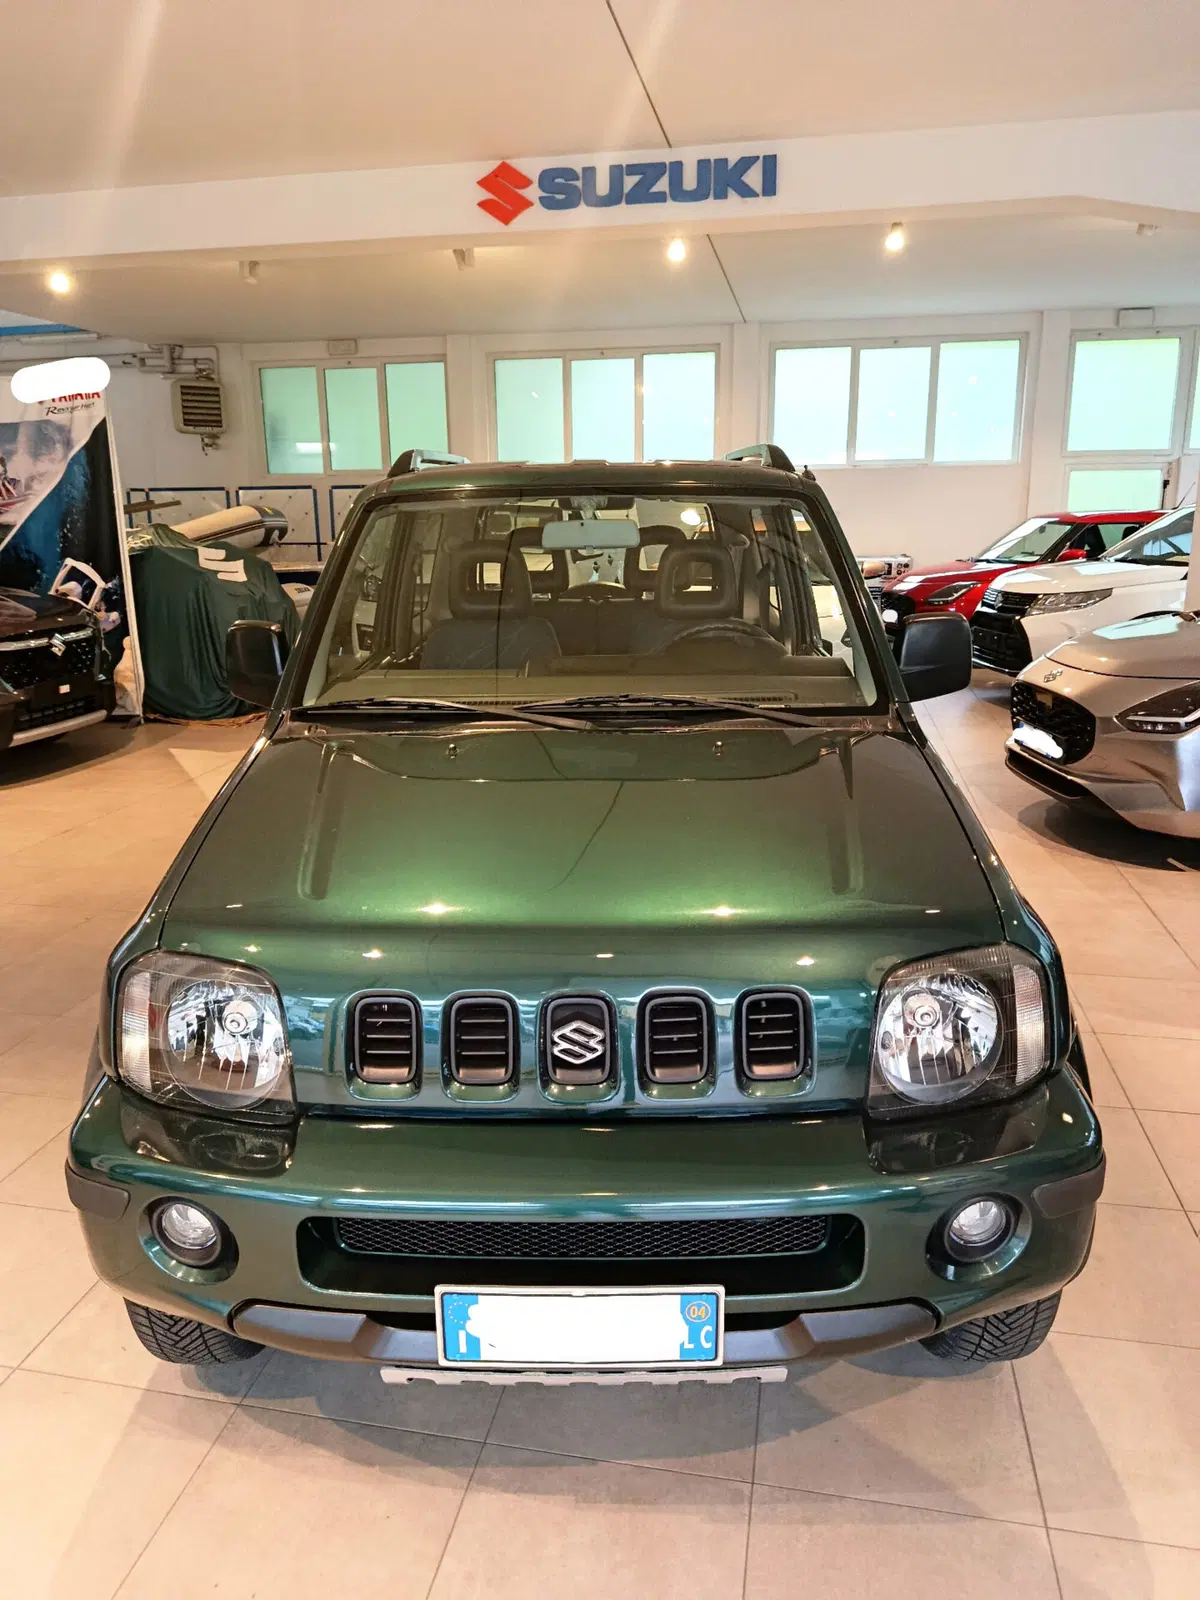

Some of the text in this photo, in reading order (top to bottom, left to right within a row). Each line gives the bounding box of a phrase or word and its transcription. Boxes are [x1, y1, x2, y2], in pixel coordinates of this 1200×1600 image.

[538, 154, 777, 210] SUZUKI
[690, 1305, 706, 1318] 04
[683, 1325, 713, 1349] LC
